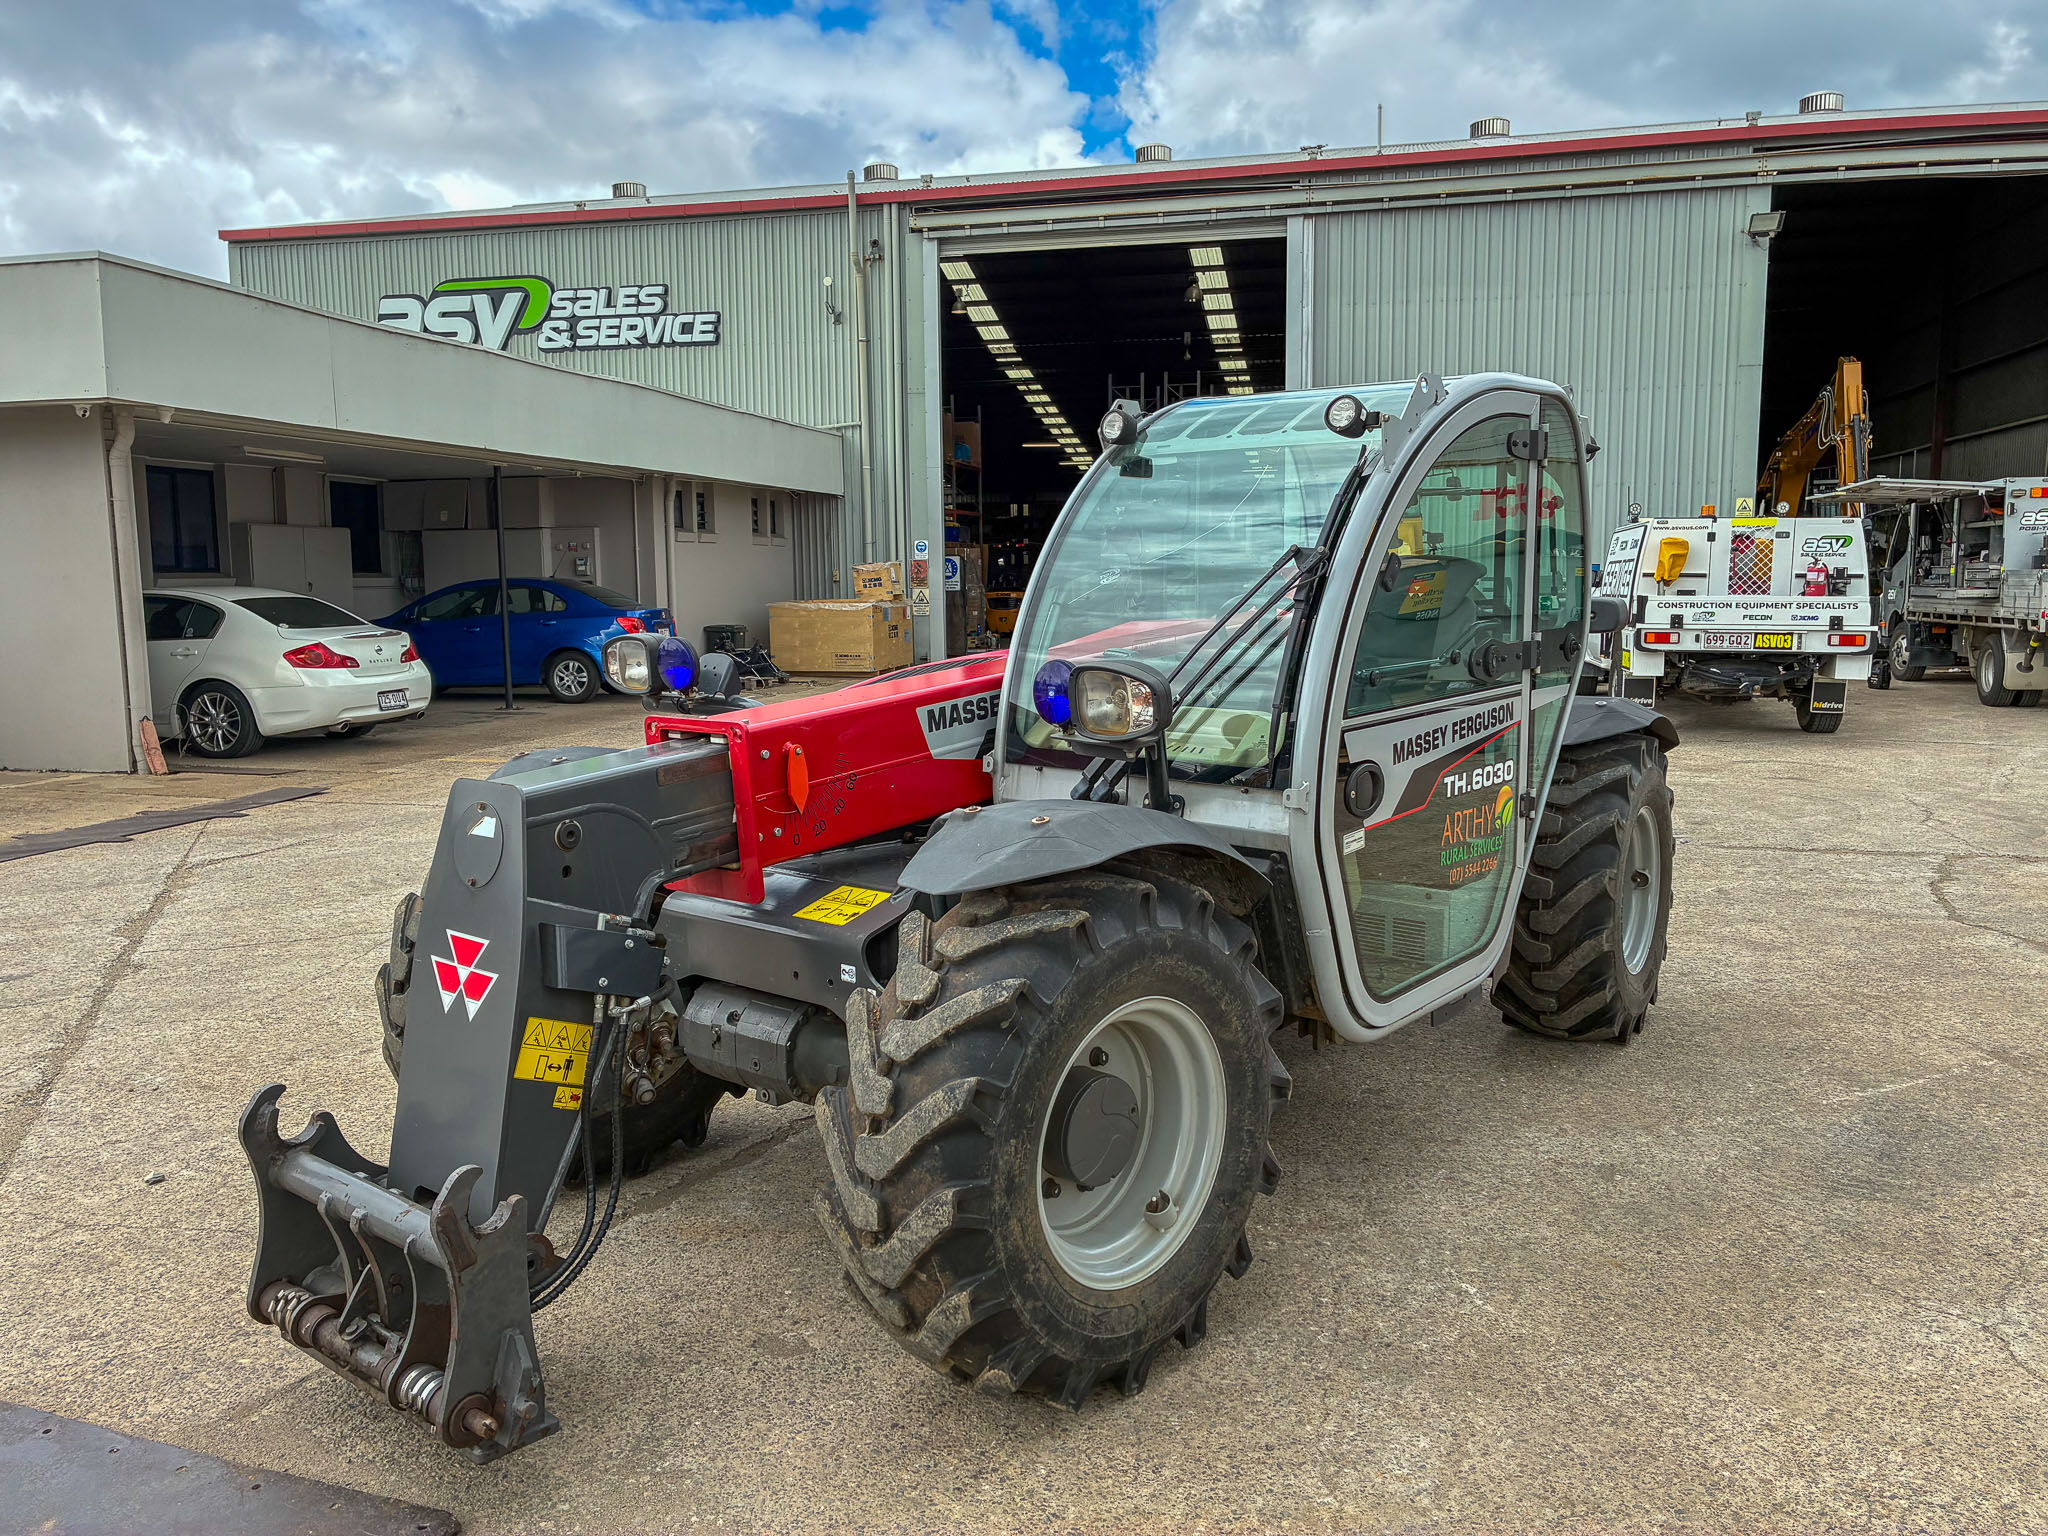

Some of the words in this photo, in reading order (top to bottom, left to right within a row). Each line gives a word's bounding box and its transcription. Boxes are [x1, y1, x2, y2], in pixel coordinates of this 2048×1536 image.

[538, 320, 575, 350] &
[577, 312, 720, 346] SERVICE
[1735, 602, 1794, 610] EQUIPMENT
[1796, 602, 1859, 610] SPECIALISTS
[1755, 634, 1792, 648] ASV03
[1813, 701, 1843, 709] hidrive
[1392, 725, 1448, 766] MASSEY
[1451, 701, 1514, 744] FERGUSON
[846, 772, 858, 790] 60
[1443, 759, 1514, 798] TH.6030
[833, 798, 846, 816] 40
[812, 819, 827, 837] 20
[1441, 802, 1496, 847] ARTHY
[793, 833, 801, 846] 0
[1440, 845, 1469, 867] RURAL
[1470, 835, 1504, 858] SERVICES
[1449, 867, 1464, 885] (07)
